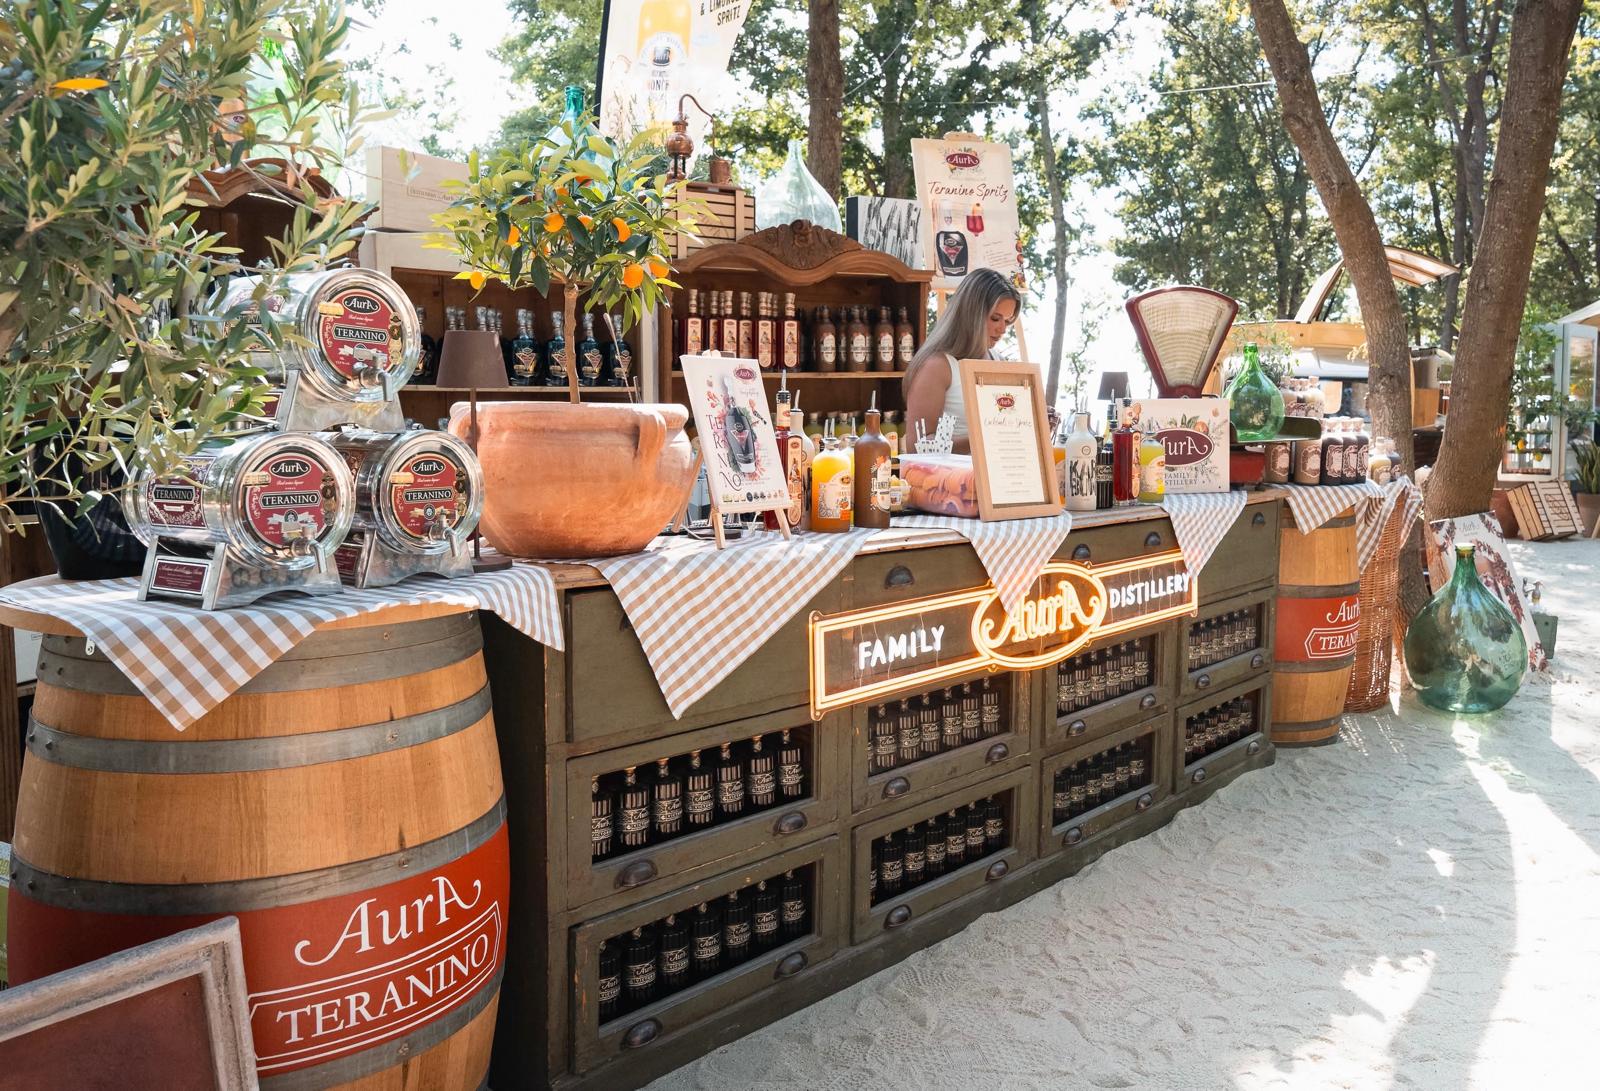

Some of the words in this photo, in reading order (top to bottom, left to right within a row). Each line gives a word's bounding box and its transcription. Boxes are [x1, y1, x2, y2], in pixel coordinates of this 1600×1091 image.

[717, 5, 741, 25] SPRITZ
[928, 181, 975, 195] Teranino
[976, 183, 1009, 203] Spritz
[335, 327, 386, 342] TERANINO
[155, 487, 193, 500] TERANINO
[263, 494, 318, 505] TERANINO
[407, 489, 452, 500] TERANINO
[858, 625, 945, 670] FAMILY
[1109, 572, 1192, 609] DISTILLERY
[276, 933, 489, 1044] TERANINO
